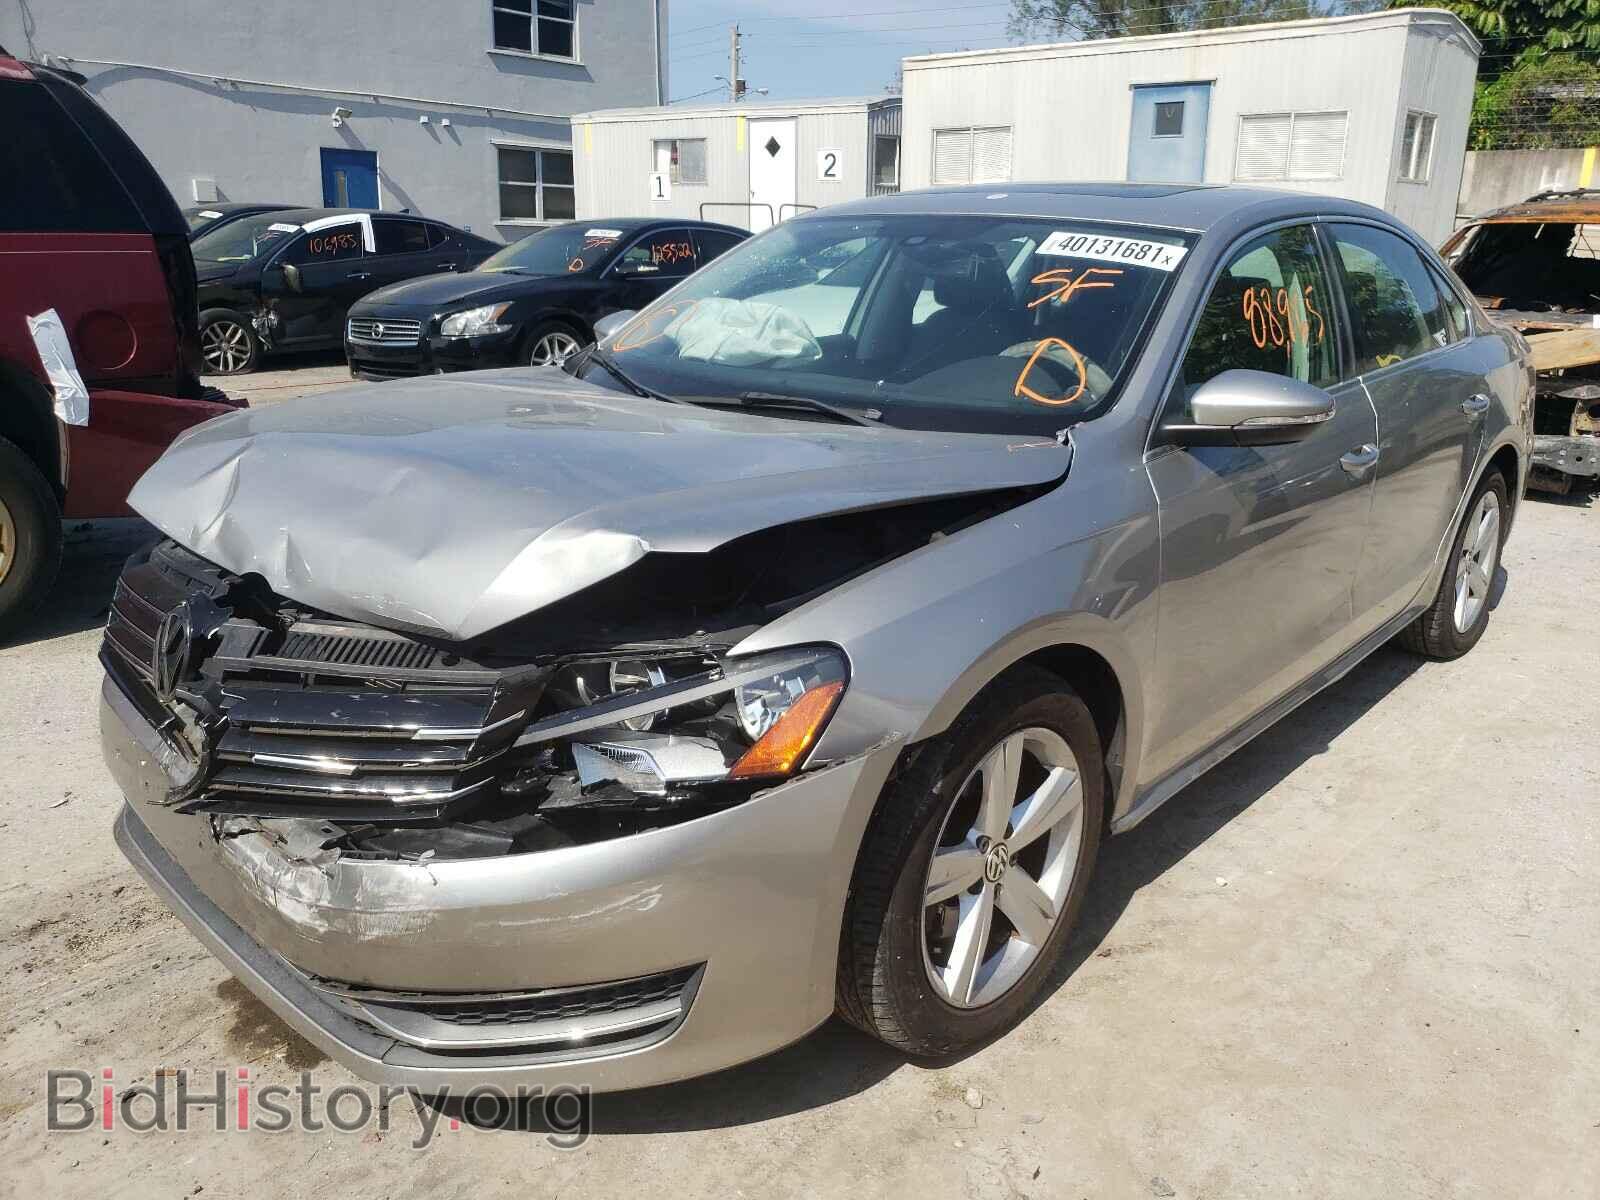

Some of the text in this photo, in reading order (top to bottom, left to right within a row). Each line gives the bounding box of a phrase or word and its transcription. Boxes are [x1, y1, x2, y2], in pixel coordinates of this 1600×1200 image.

[823, 152, 837, 178] 2
[655, 175, 665, 198] 1
[1026, 268, 1125, 309] SF
